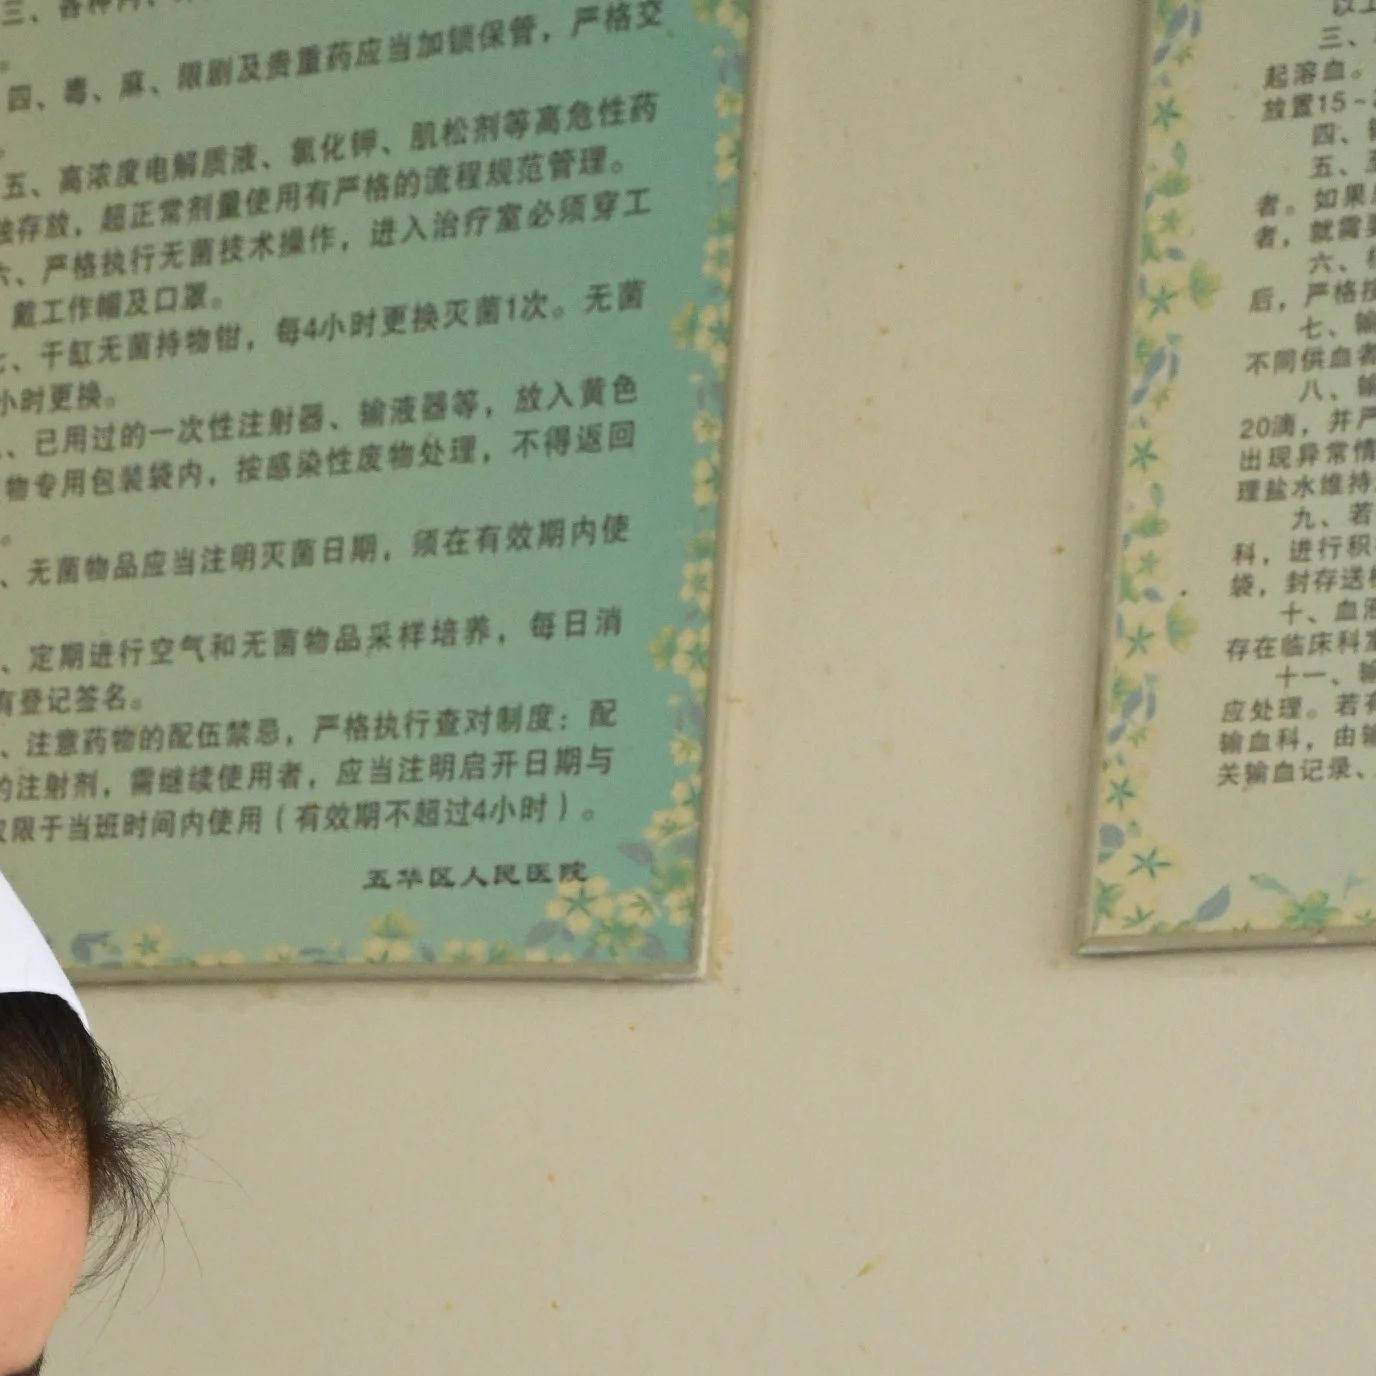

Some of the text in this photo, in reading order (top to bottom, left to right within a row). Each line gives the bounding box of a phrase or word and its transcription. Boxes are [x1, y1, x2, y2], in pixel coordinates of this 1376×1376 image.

[362, 860, 589, 892] 五华区人民医院
